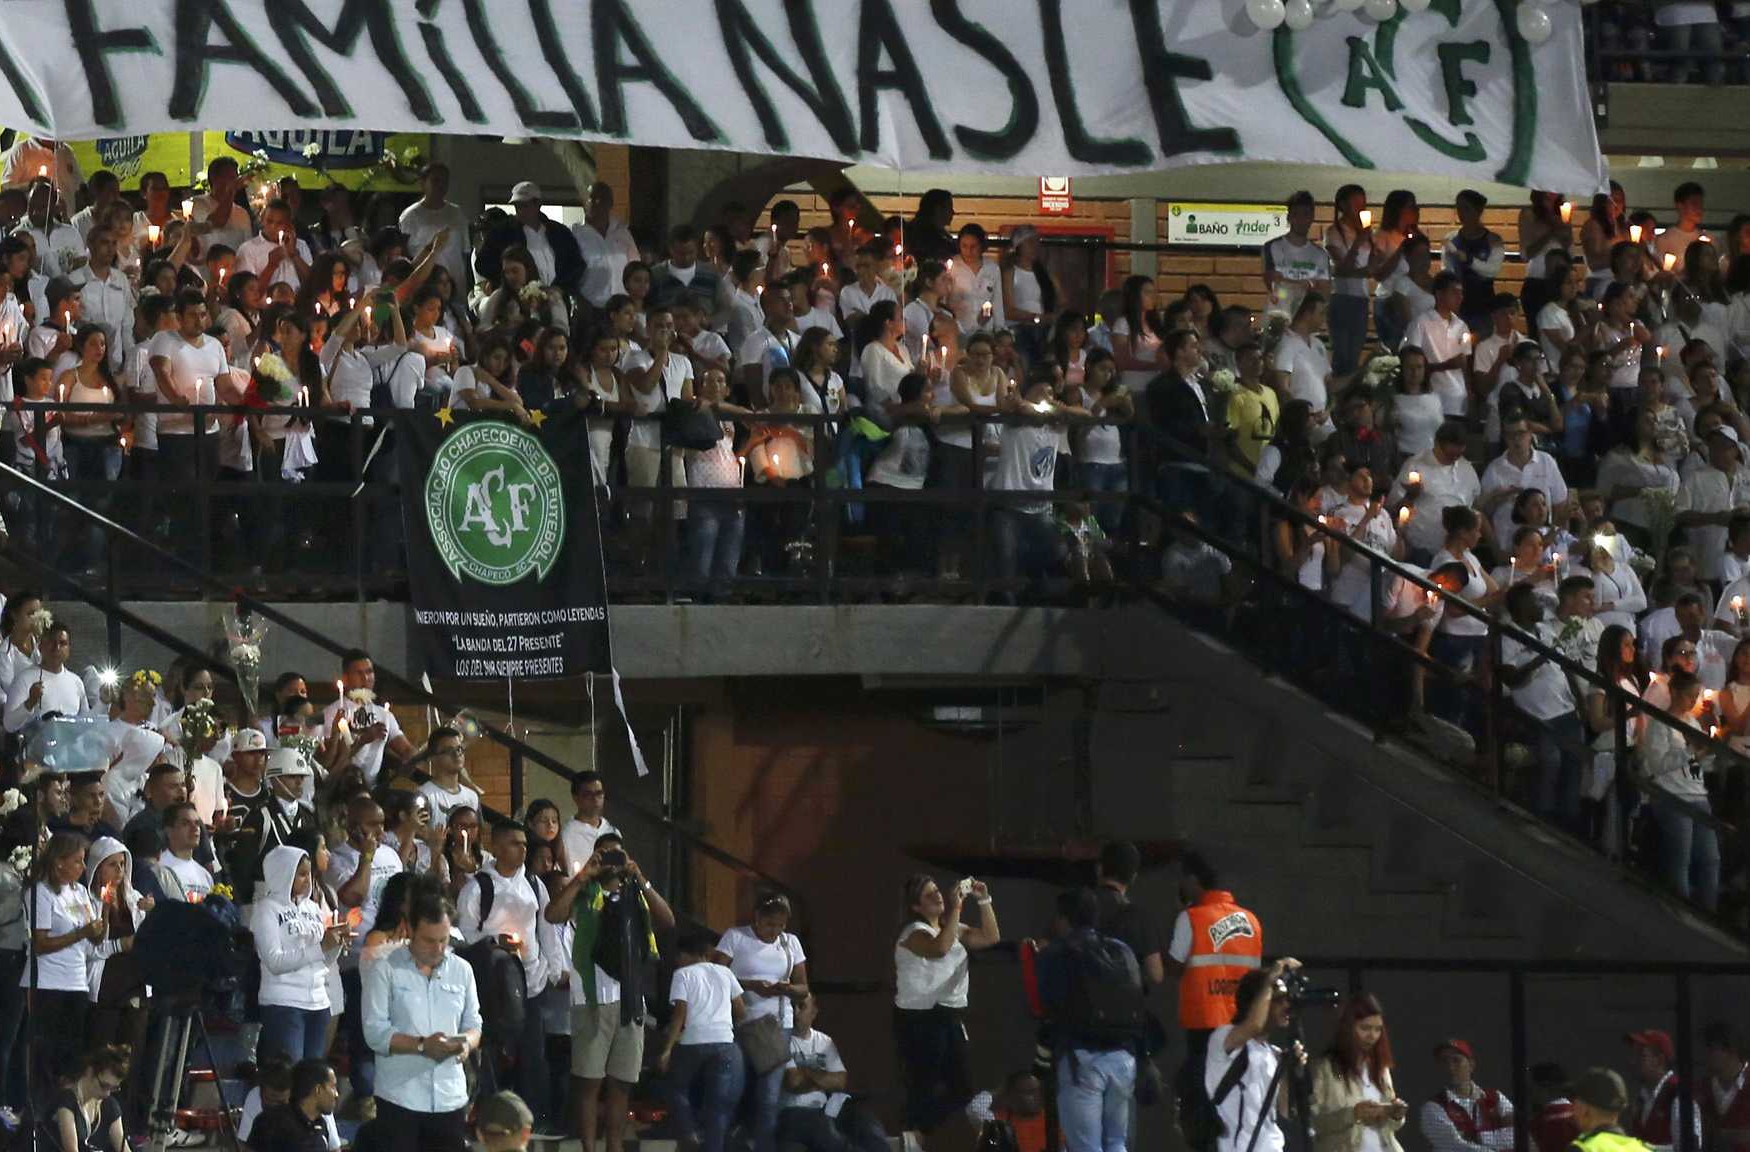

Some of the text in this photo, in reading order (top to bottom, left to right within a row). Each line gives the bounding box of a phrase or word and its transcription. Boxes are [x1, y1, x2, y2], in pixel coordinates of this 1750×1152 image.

[1199, 221, 1228, 235] BAÑO
[1274, 216, 1281, 227] 3
[449, 428, 541, 465] CHAPECOENSE
[537, 463, 556, 486] DE
[458, 464, 536, 548] ACF
[535, 486, 558, 560] FUTEBOL
[445, 611, 459, 625] POR
[461, 611, 472, 625] UN
[499, 611, 540, 627] PARTIERON
[541, 610, 566, 624] COMO
[567, 607, 605, 622] LEYENDAS
[507, 636, 517, 651] 27
[455, 659, 469, 676] LOS
[470, 659, 483, 676] DEL
[524, 656, 564, 676] PRESENTES
